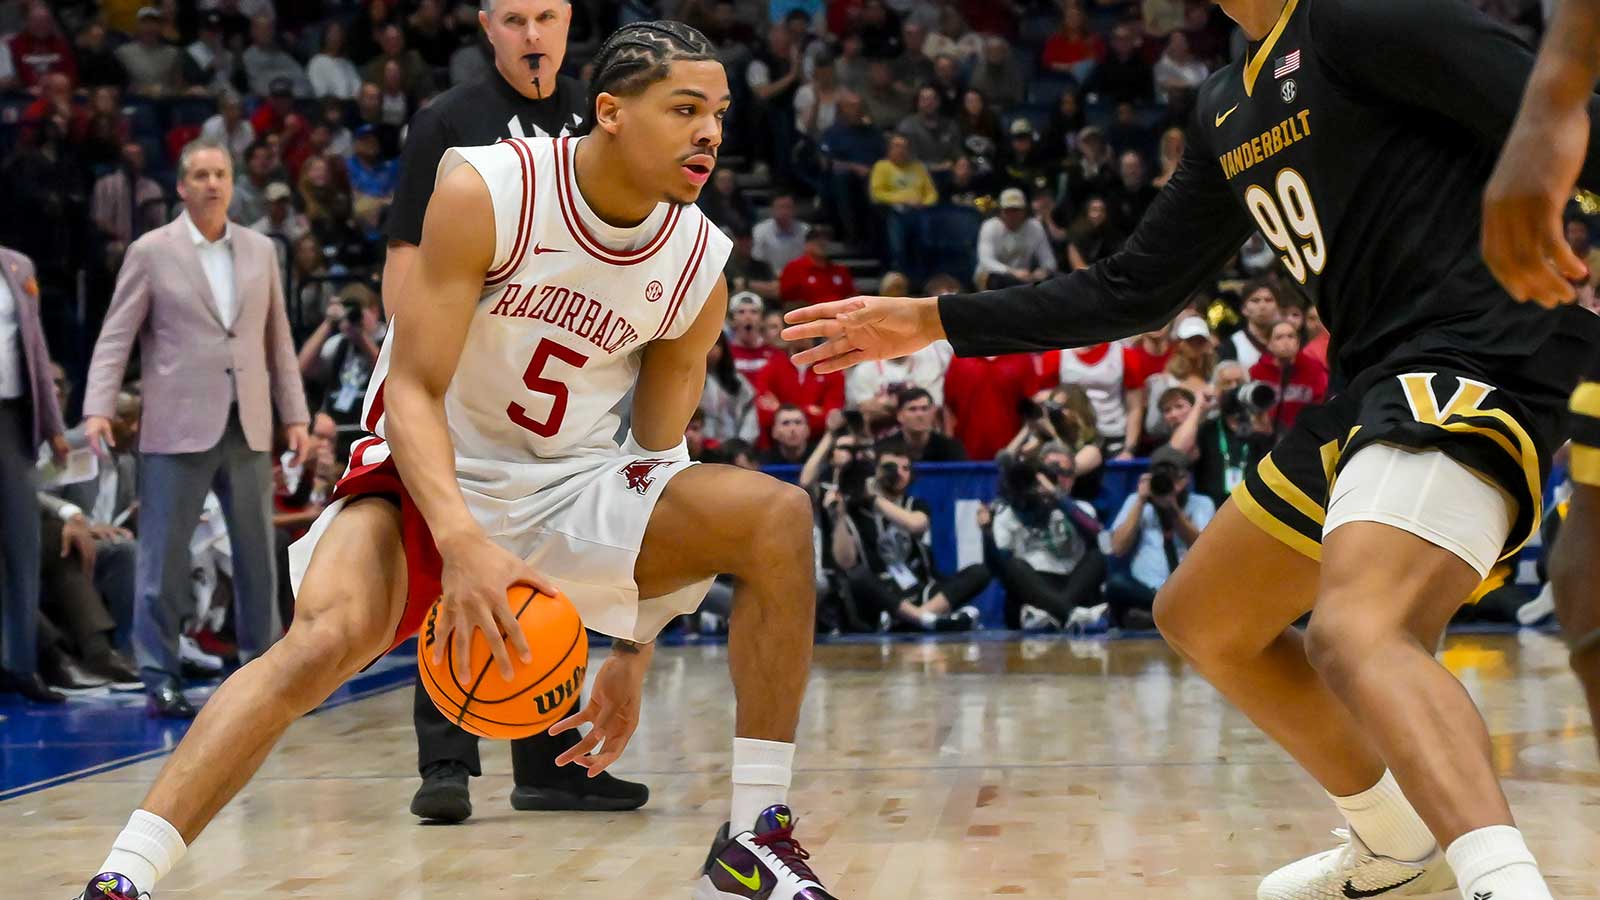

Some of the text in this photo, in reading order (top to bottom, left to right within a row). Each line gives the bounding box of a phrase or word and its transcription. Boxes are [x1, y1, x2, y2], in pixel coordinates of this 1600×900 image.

[1219, 109, 1311, 180] VANDERBILT
[1245, 167, 1327, 284] 99
[506, 337, 589, 438] 5
[1396, 372, 1497, 425] V
